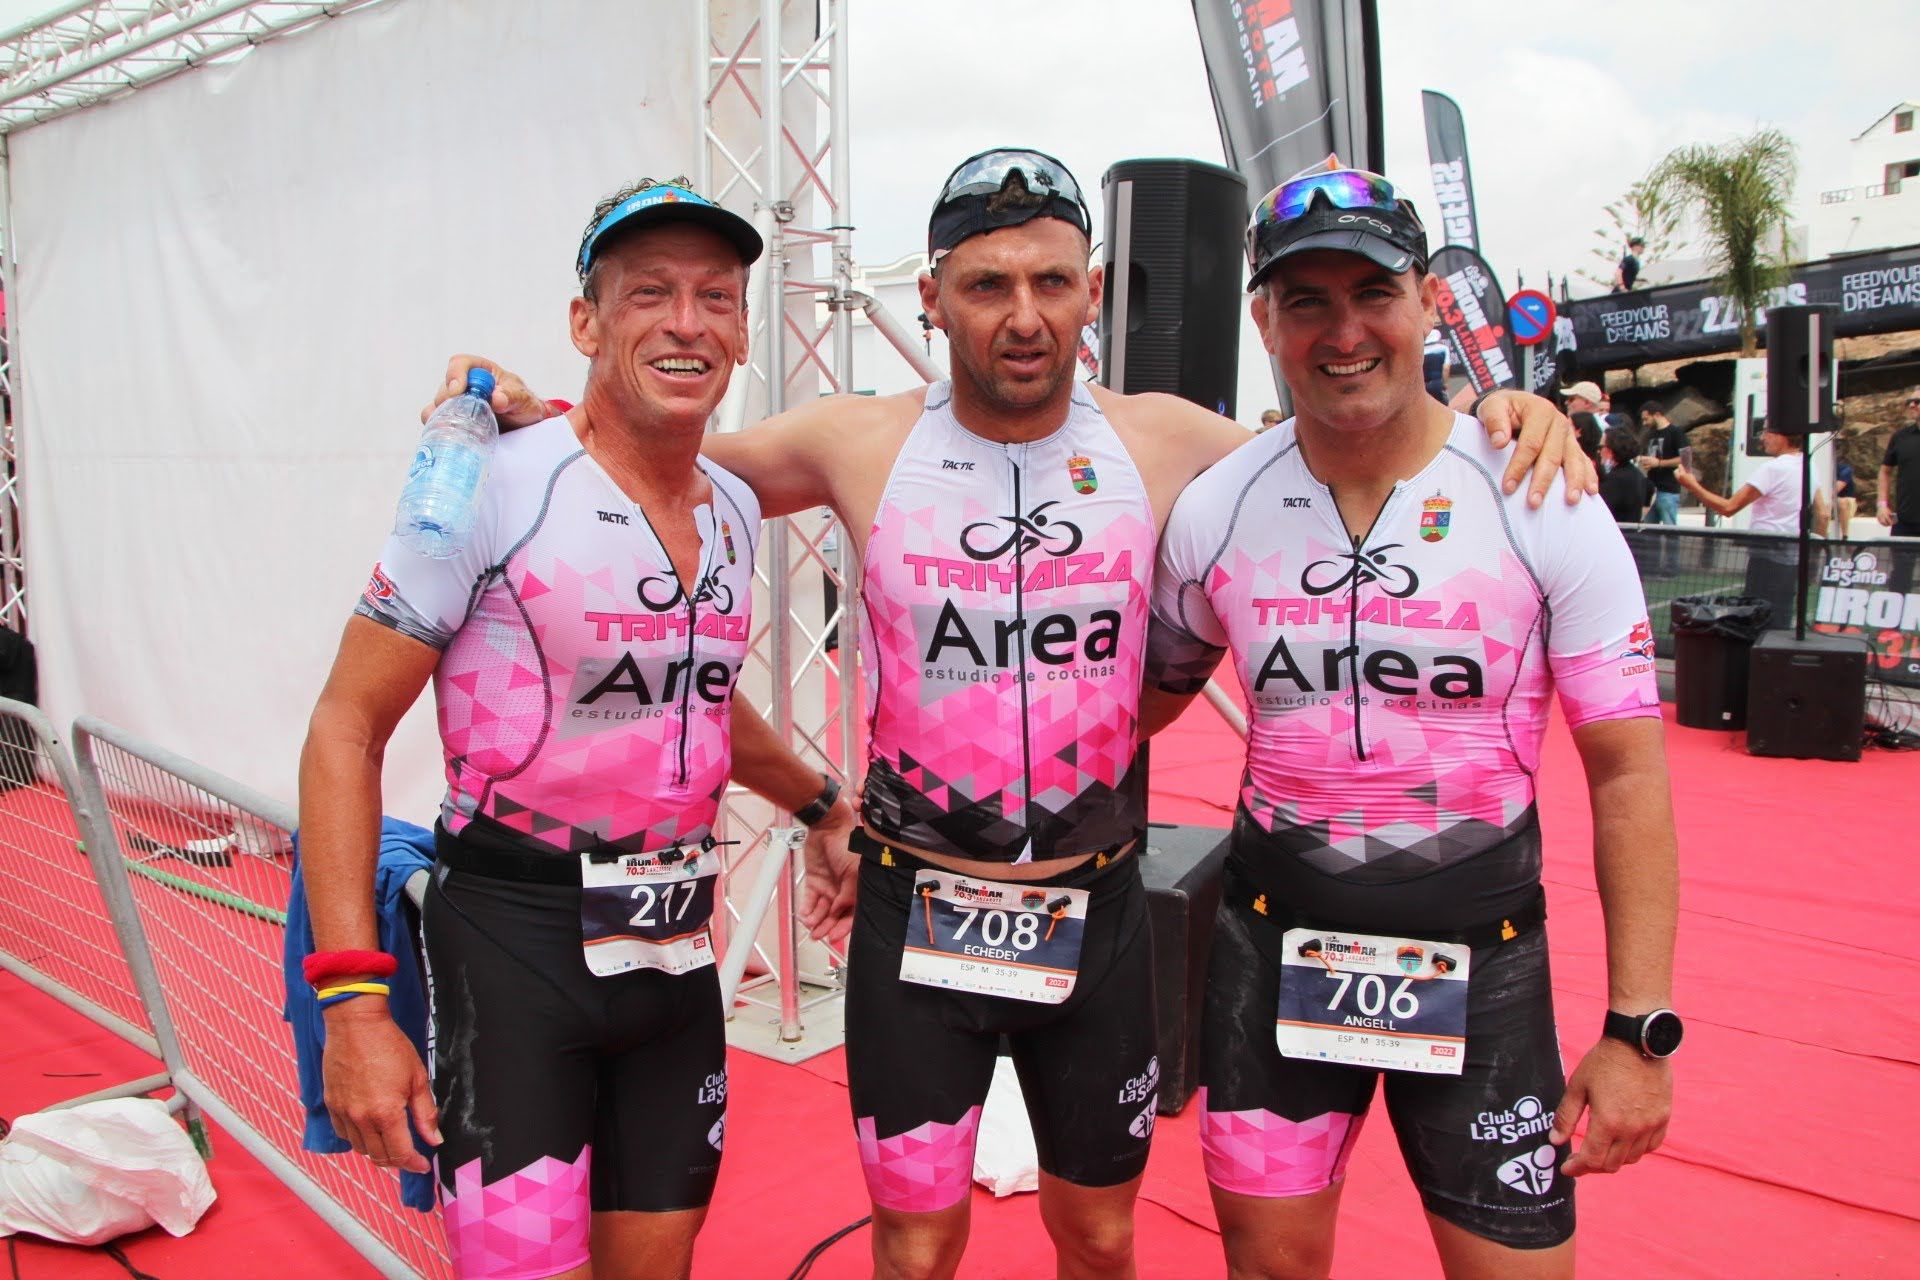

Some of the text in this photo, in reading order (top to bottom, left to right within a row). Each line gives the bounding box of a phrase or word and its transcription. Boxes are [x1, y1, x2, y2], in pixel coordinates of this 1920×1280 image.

[1245, 1, 1277, 100] ROTE
[1239, 33, 1263, 108] SPAIN
[1337, 214, 1392, 234] orca
[1446, 270, 1513, 386] IRONMAN
[1606, 320, 1670, 343] DREAMS
[1456, 324, 1495, 389] LANZAROTE
[942, 459, 976, 471] TACTIC
[1282, 497, 1311, 508] TACTIC
[596, 510, 629, 526] TACTIC
[903, 550, 1132, 594] TRIYAIZA
[1829, 557, 1855, 570] Club
[1822, 565, 1887, 587] LaSanta
[1251, 596, 1481, 631] TRIYAIZA
[925, 597, 1122, 668] Area
[925, 664, 1116, 684] estudio de cocinas
[1254, 634, 1484, 699] Area
[1256, 693, 1482, 710] estudio de cocinas
[571, 707, 664, 721] estudio
[626, 867, 645, 876] 70.3
[953, 890, 973, 901] 70.3
[954, 884, 1003, 898] IRONMAN
[628, 880, 697, 927] 217
[952, 905, 1039, 951] 708
[963, 944, 1020, 961] ECHEDEY
[1324, 952, 1344, 962] 70.3
[1325, 941, 1376, 956] IRONMAN
[960, 963, 1018, 978] ESP M 35-39
[1048, 977, 1066, 988] 2022
[1325, 971, 1419, 1019] 706
[1343, 1015, 1396, 1031] ANGEL L
[1338, 1034, 1400, 1048] ESP M 35-39
[1433, 1047, 1454, 1056] 2022
[705, 1069, 725, 1088] Club
[1126, 1073, 1147, 1091] Club
[1477, 1109, 1516, 1125] Club
